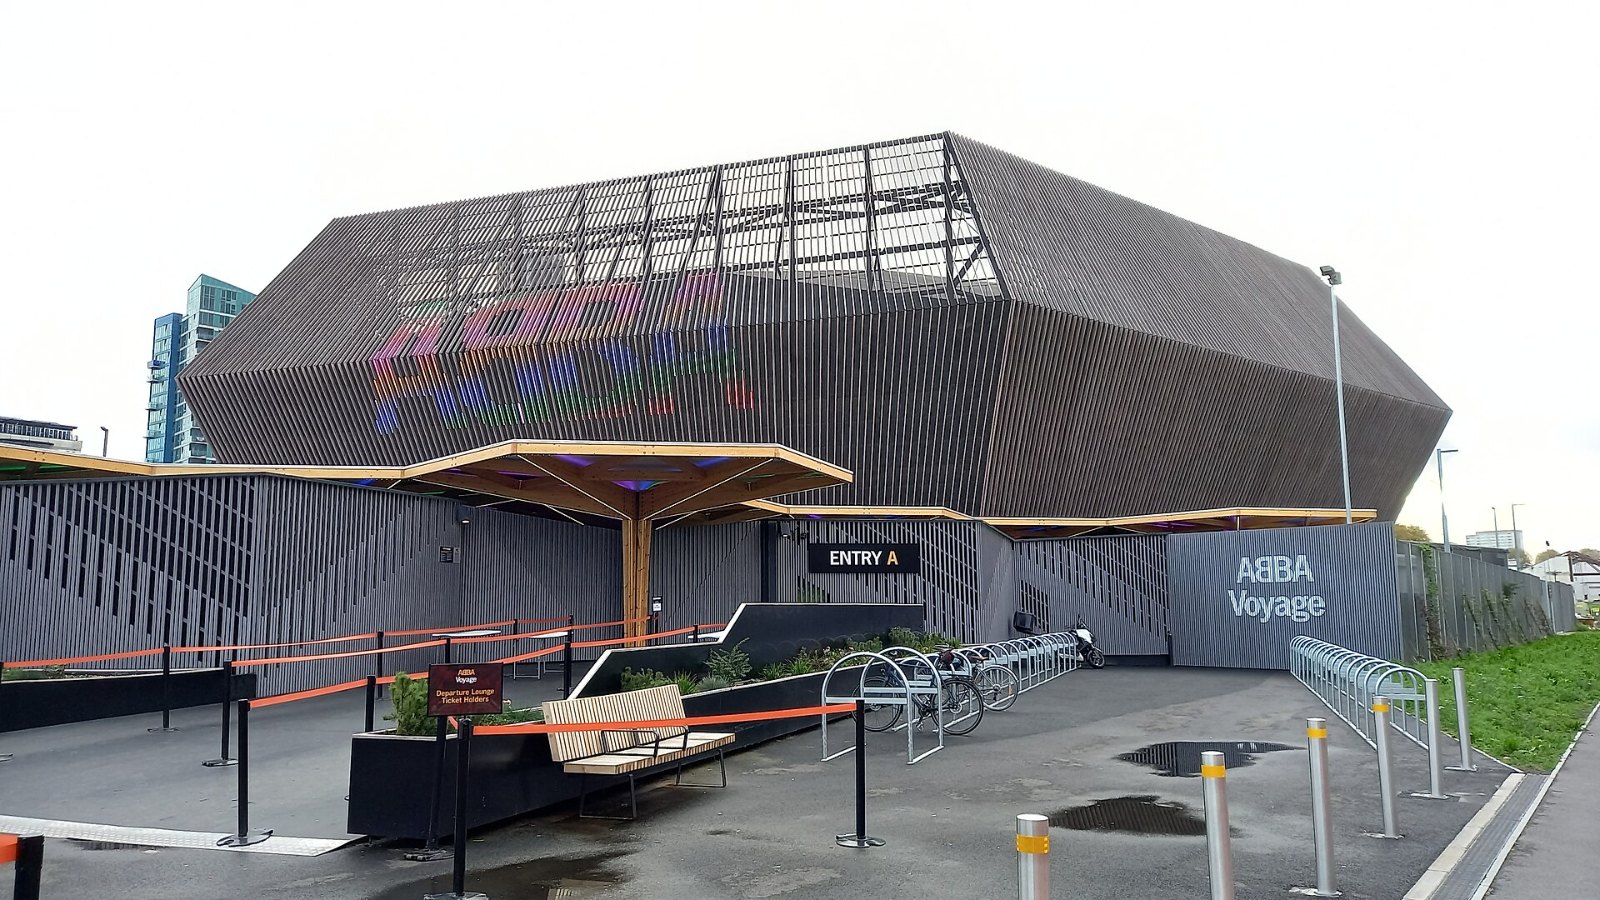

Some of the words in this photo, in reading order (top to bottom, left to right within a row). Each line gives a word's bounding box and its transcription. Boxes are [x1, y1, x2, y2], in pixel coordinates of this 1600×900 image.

[830, 550, 882, 566] ENTRY
[887, 550, 899, 566] A
[1237, 554, 1315, 584] ABBA
[1227, 589, 1326, 623] Voyage
[455, 676, 478, 684] Voyage
